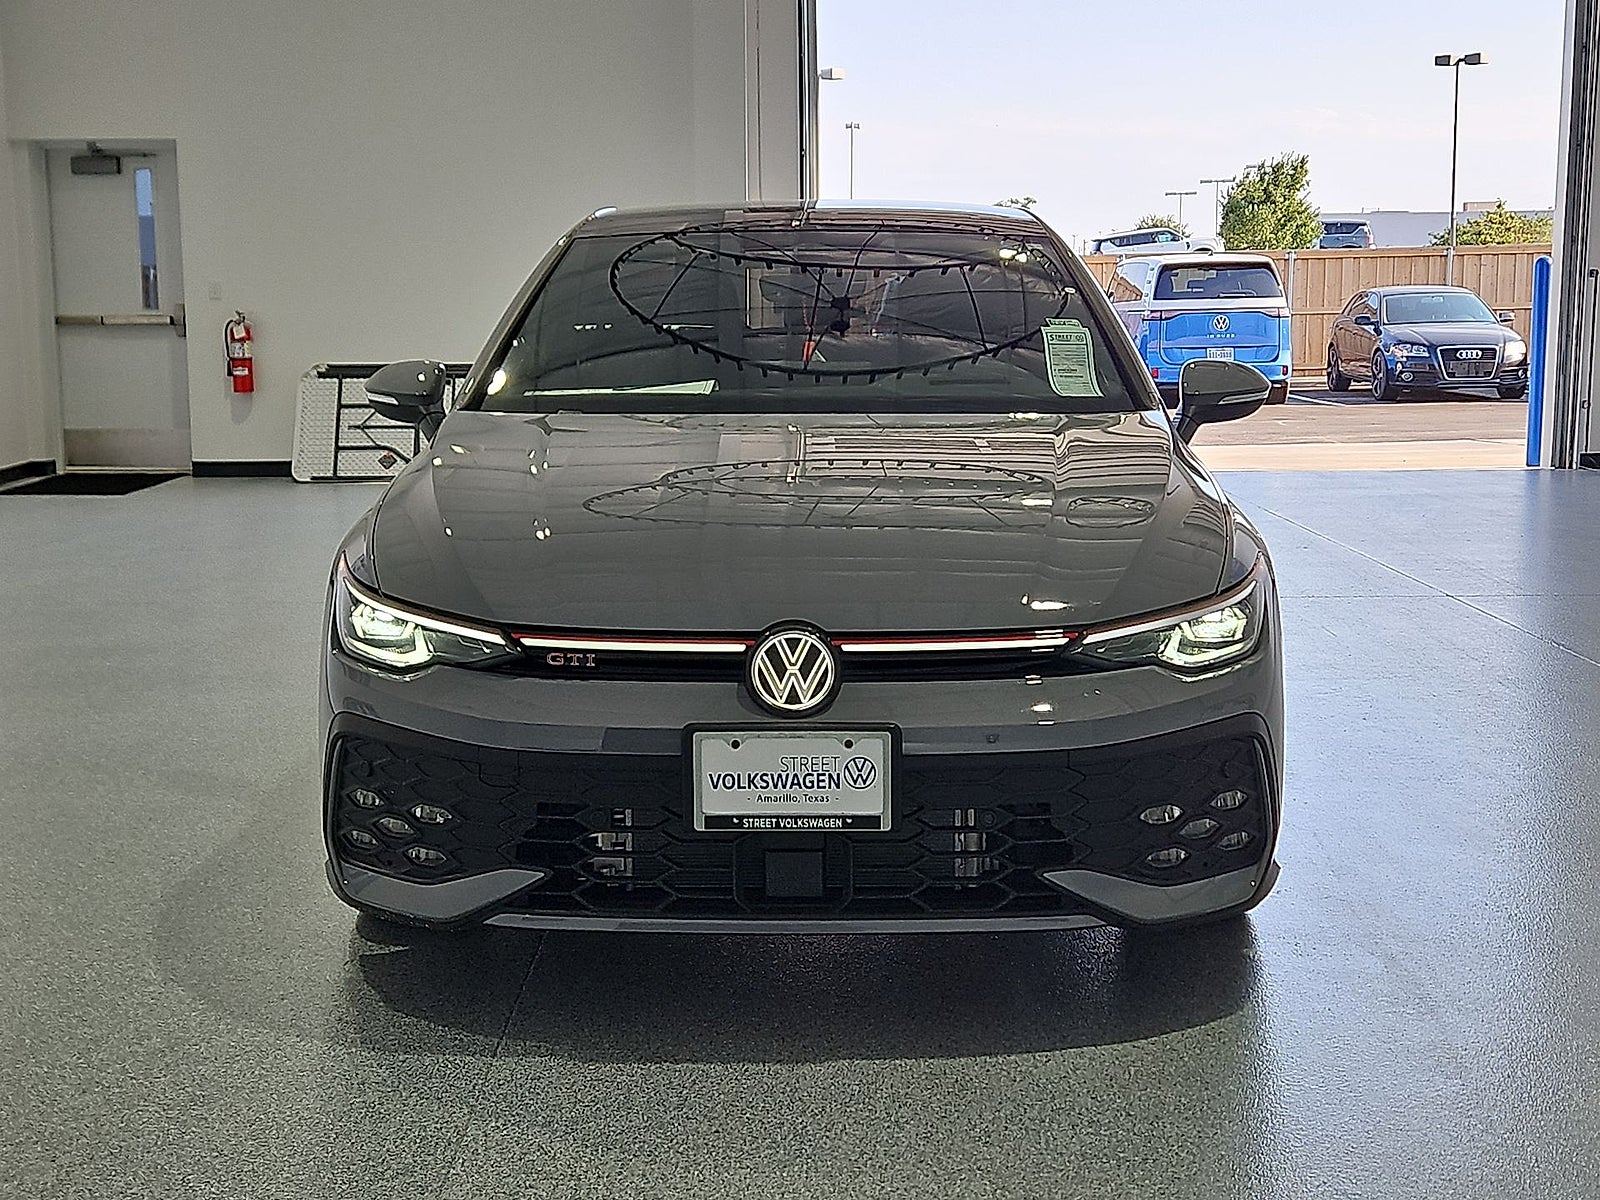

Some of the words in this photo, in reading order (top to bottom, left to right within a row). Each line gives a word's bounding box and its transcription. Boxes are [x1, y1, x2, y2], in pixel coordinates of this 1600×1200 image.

[546, 652, 597, 667] GTI
[779, 755, 841, 772] STREET
[708, 772, 841, 790] VOLKSWAGEN
[756, 794, 801, 804] Amarillo,
[803, 794, 830, 803] Texas
[742, 818, 776, 828] STREET
[779, 818, 843, 828] VOLKSWAGEN
